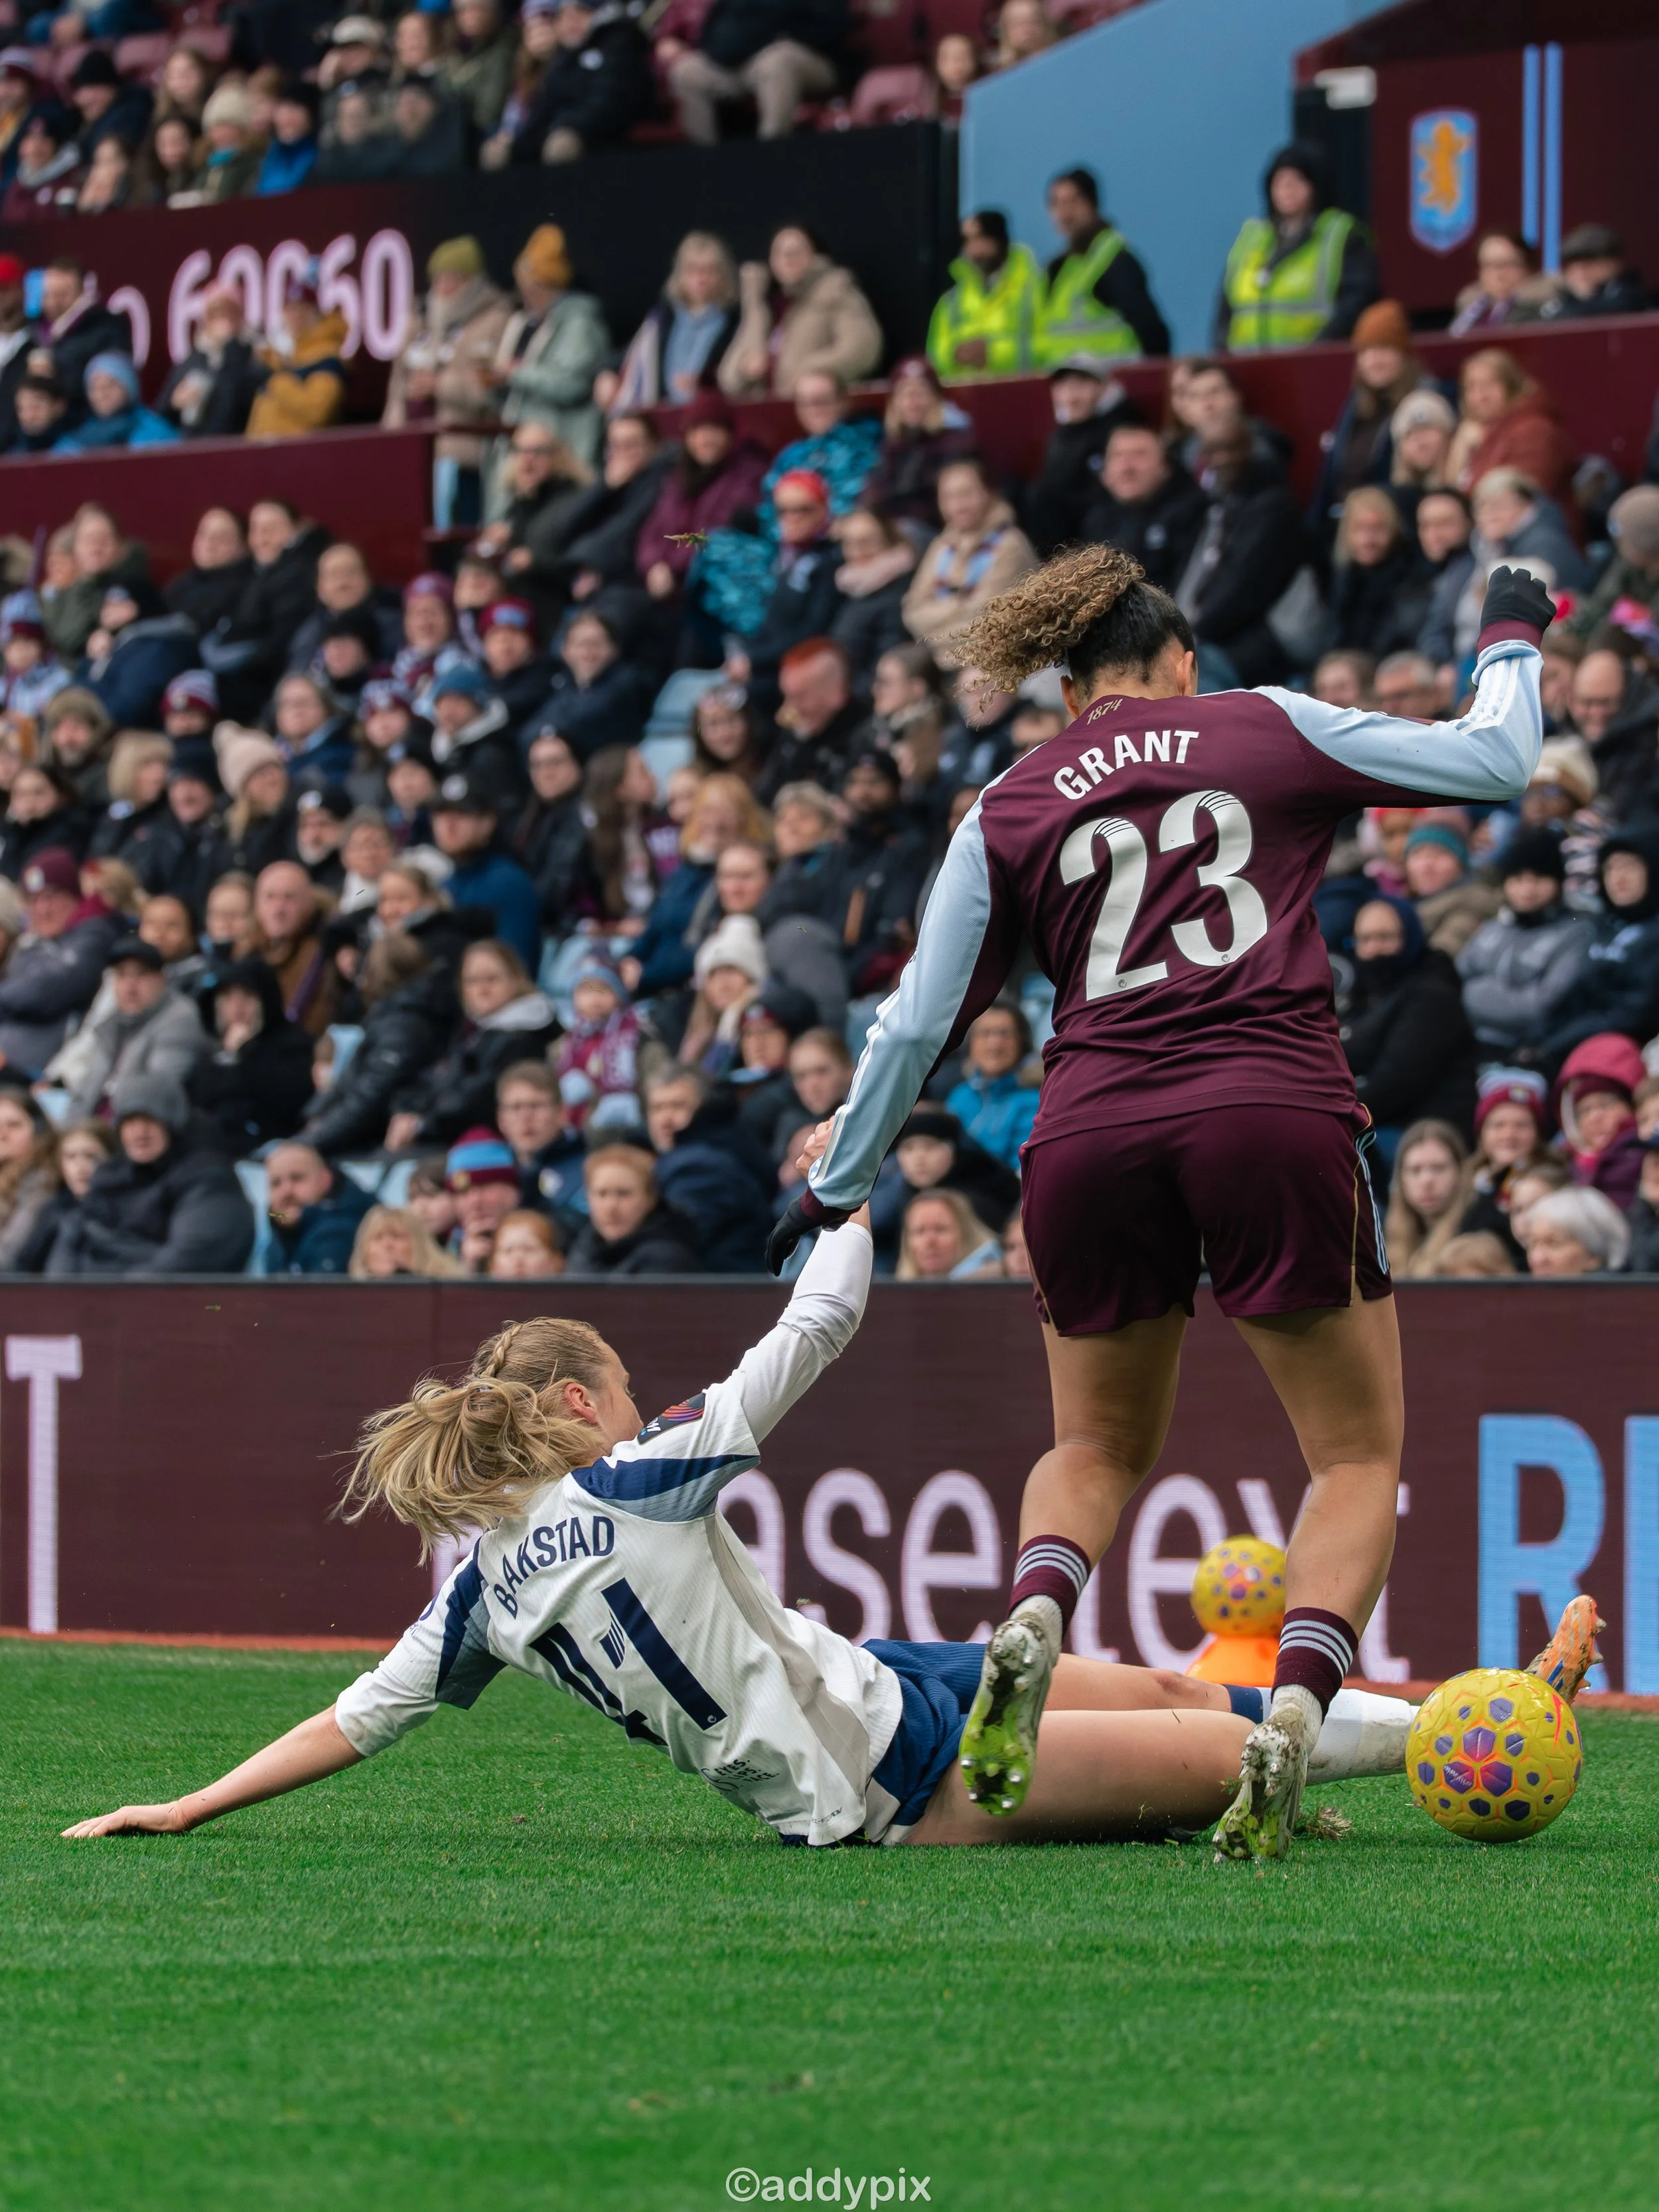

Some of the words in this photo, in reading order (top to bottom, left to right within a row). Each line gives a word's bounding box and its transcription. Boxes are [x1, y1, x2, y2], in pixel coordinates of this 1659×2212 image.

[1086, 698, 1123, 725] 1874
[1052, 729, 1199, 800] GRANT
[1060, 789, 1268, 1001] 23
